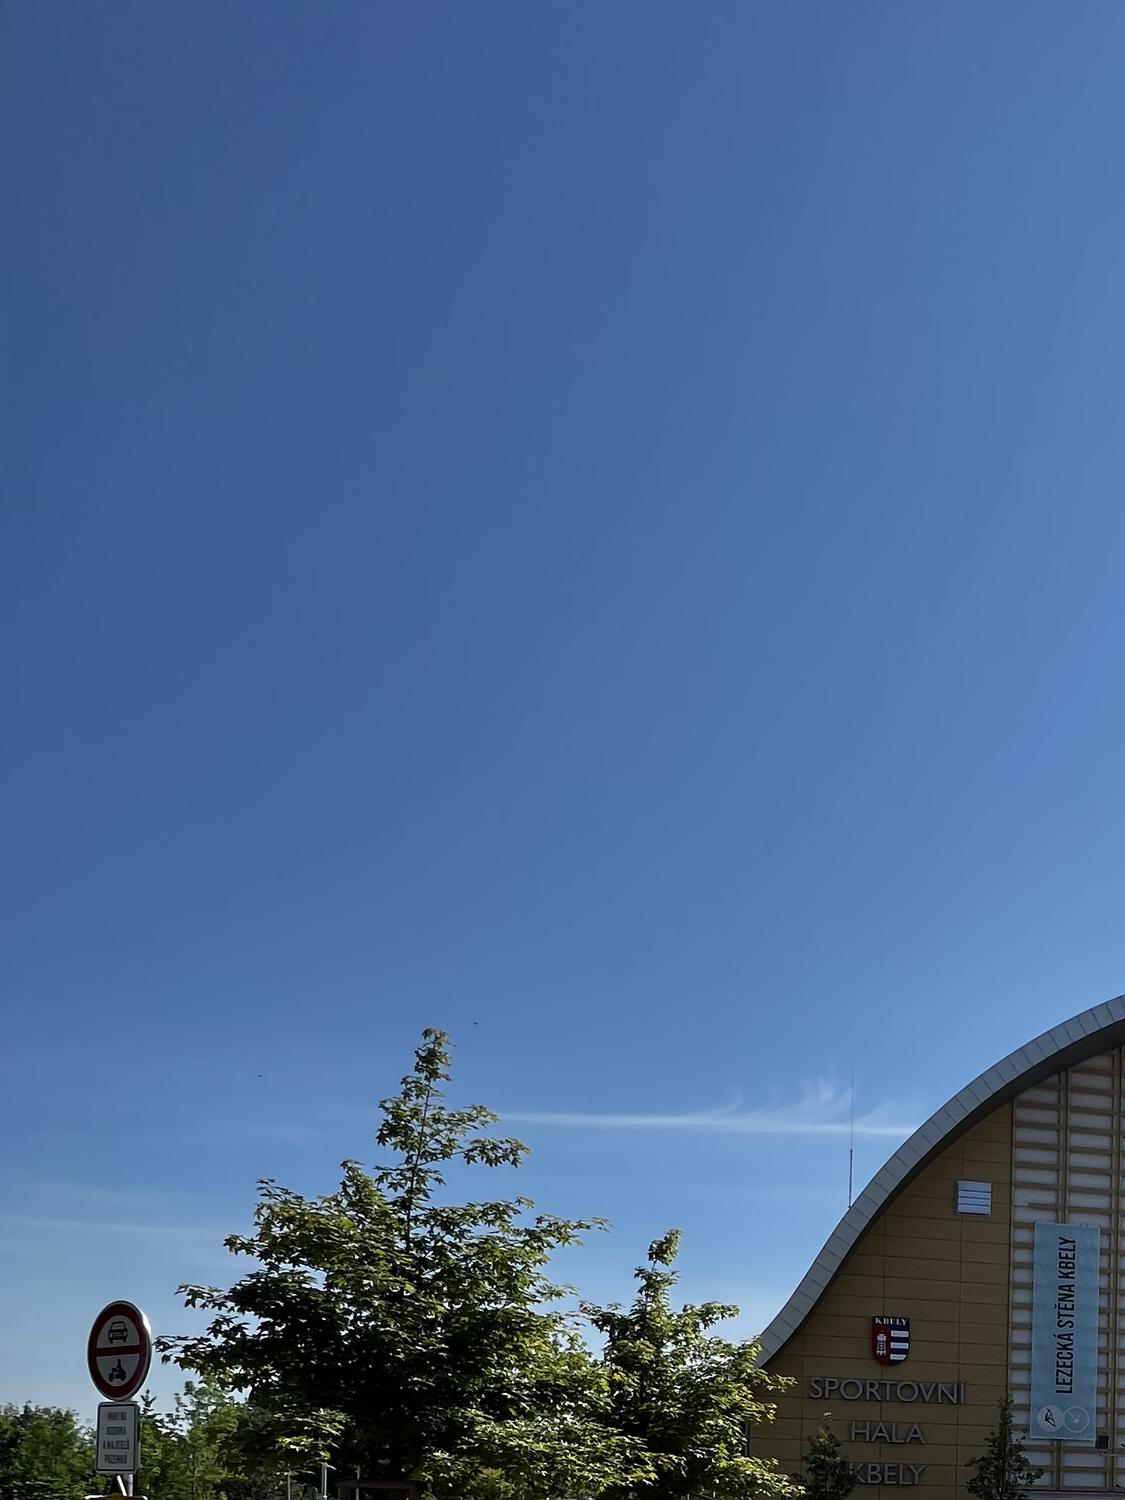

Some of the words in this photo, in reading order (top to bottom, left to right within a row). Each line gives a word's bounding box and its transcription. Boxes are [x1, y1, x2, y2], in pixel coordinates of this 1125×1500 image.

[1057, 1237, 1077, 1280] KBELY
[874, 1316, 909, 1327] KBELY
[1054, 1284, 1075, 1328] STĚNA
[1053, 1332, 1075, 1394] LEZECKÁ
[850, 1420, 925, 1444] HALA
